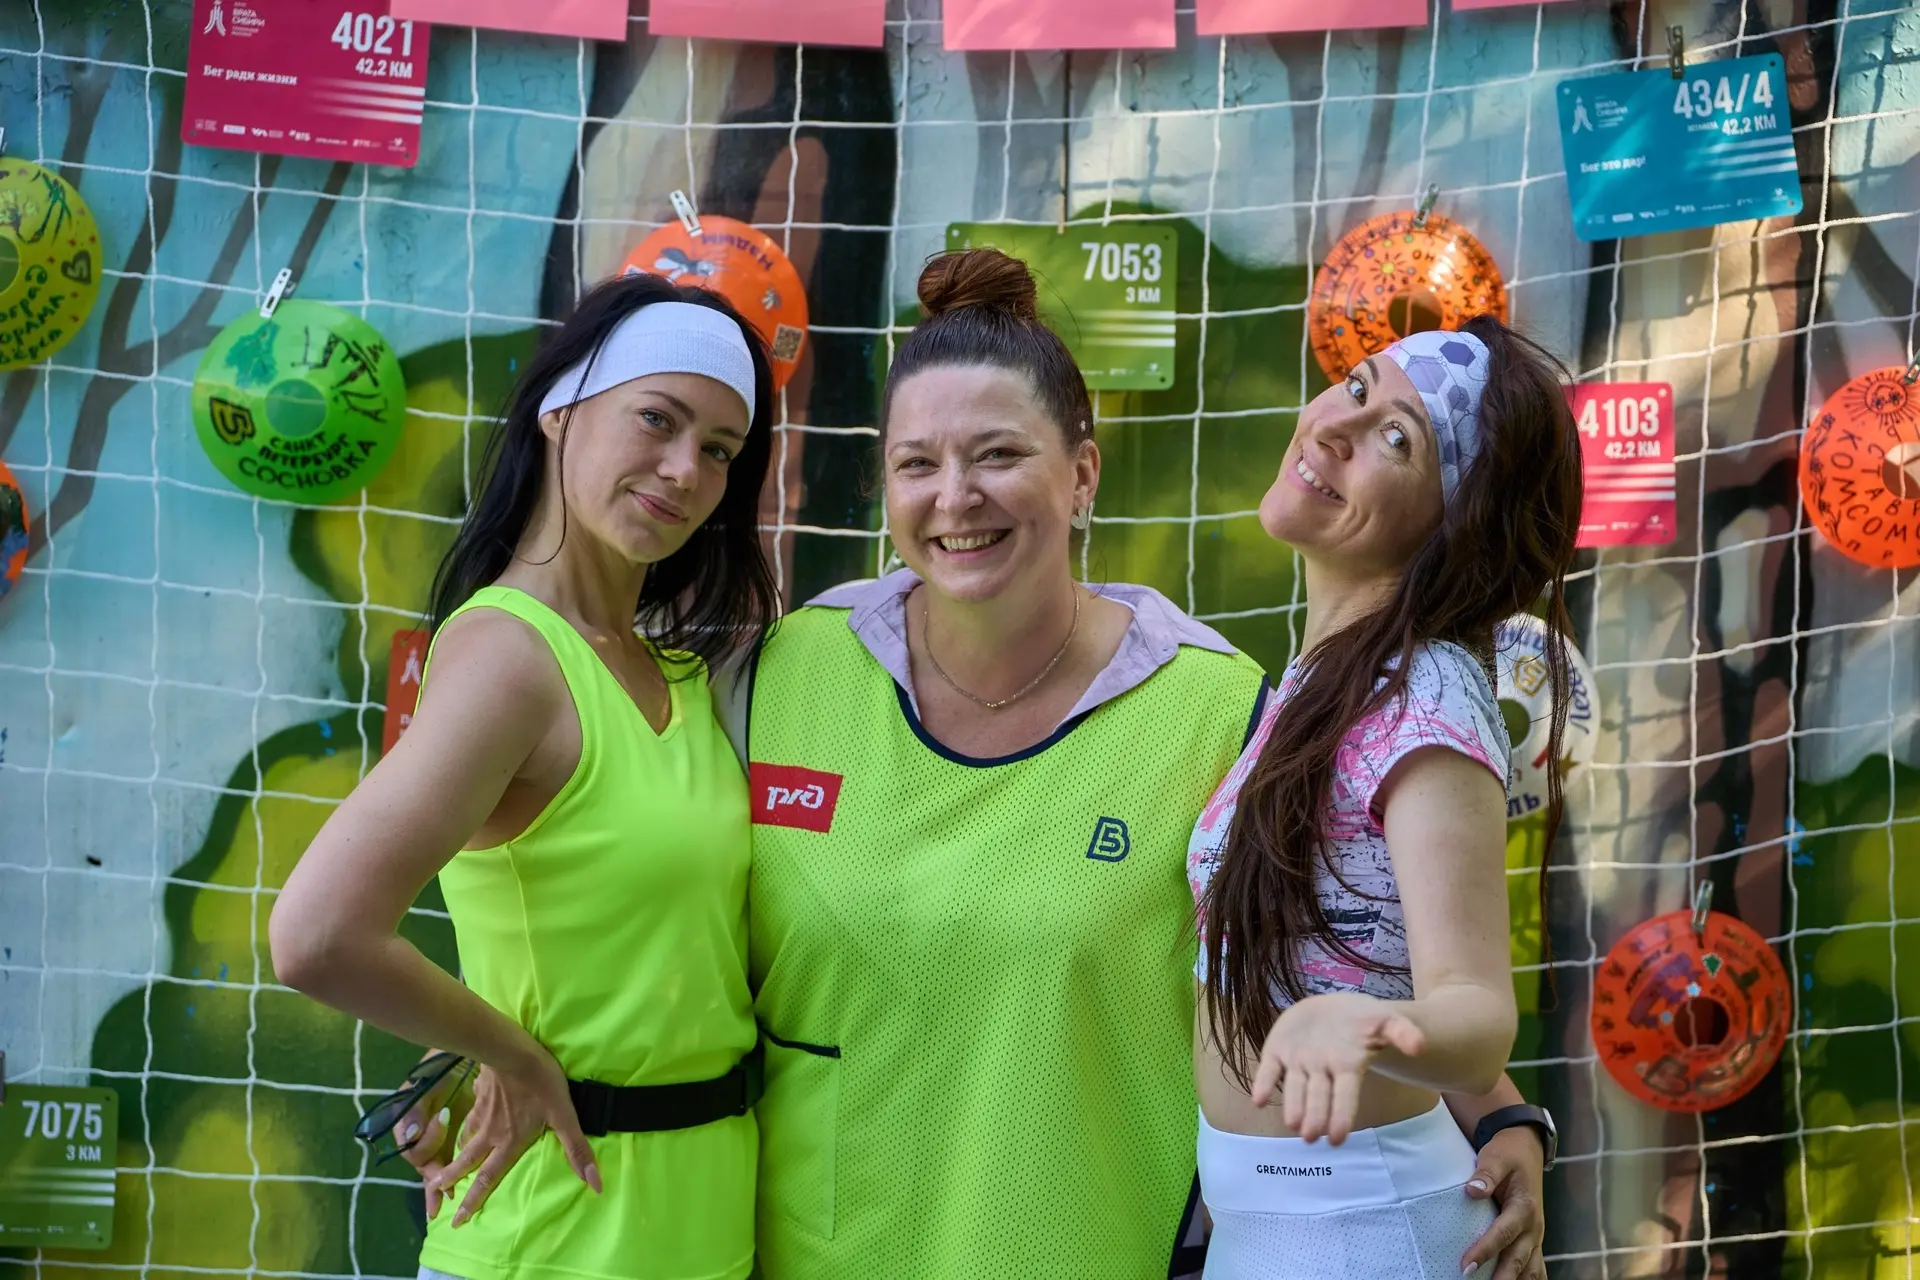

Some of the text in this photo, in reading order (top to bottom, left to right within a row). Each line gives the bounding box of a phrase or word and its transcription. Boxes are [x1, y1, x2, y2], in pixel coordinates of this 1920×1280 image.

[331, 10, 414, 57] 4021
[203, 64, 298, 86] Бег ради жизни
[355, 57, 413, 79] 42,2 КМ
[1673, 70, 1774, 119] 434/4
[1722, 116, 1752, 136] 42,2
[1081, 241, 1162, 282] 7053
[1125, 286, 1136, 303] 3
[1578, 396, 1660, 439] 4103
[1604, 440, 1636, 460] 42,2
[238, 439, 378, 490] СОСНОВКА
[21, 1100, 103, 1141] 7075
[66, 1144, 75, 1161] 3
[1256, 1164, 1332, 1177] GREATAIMATIS
